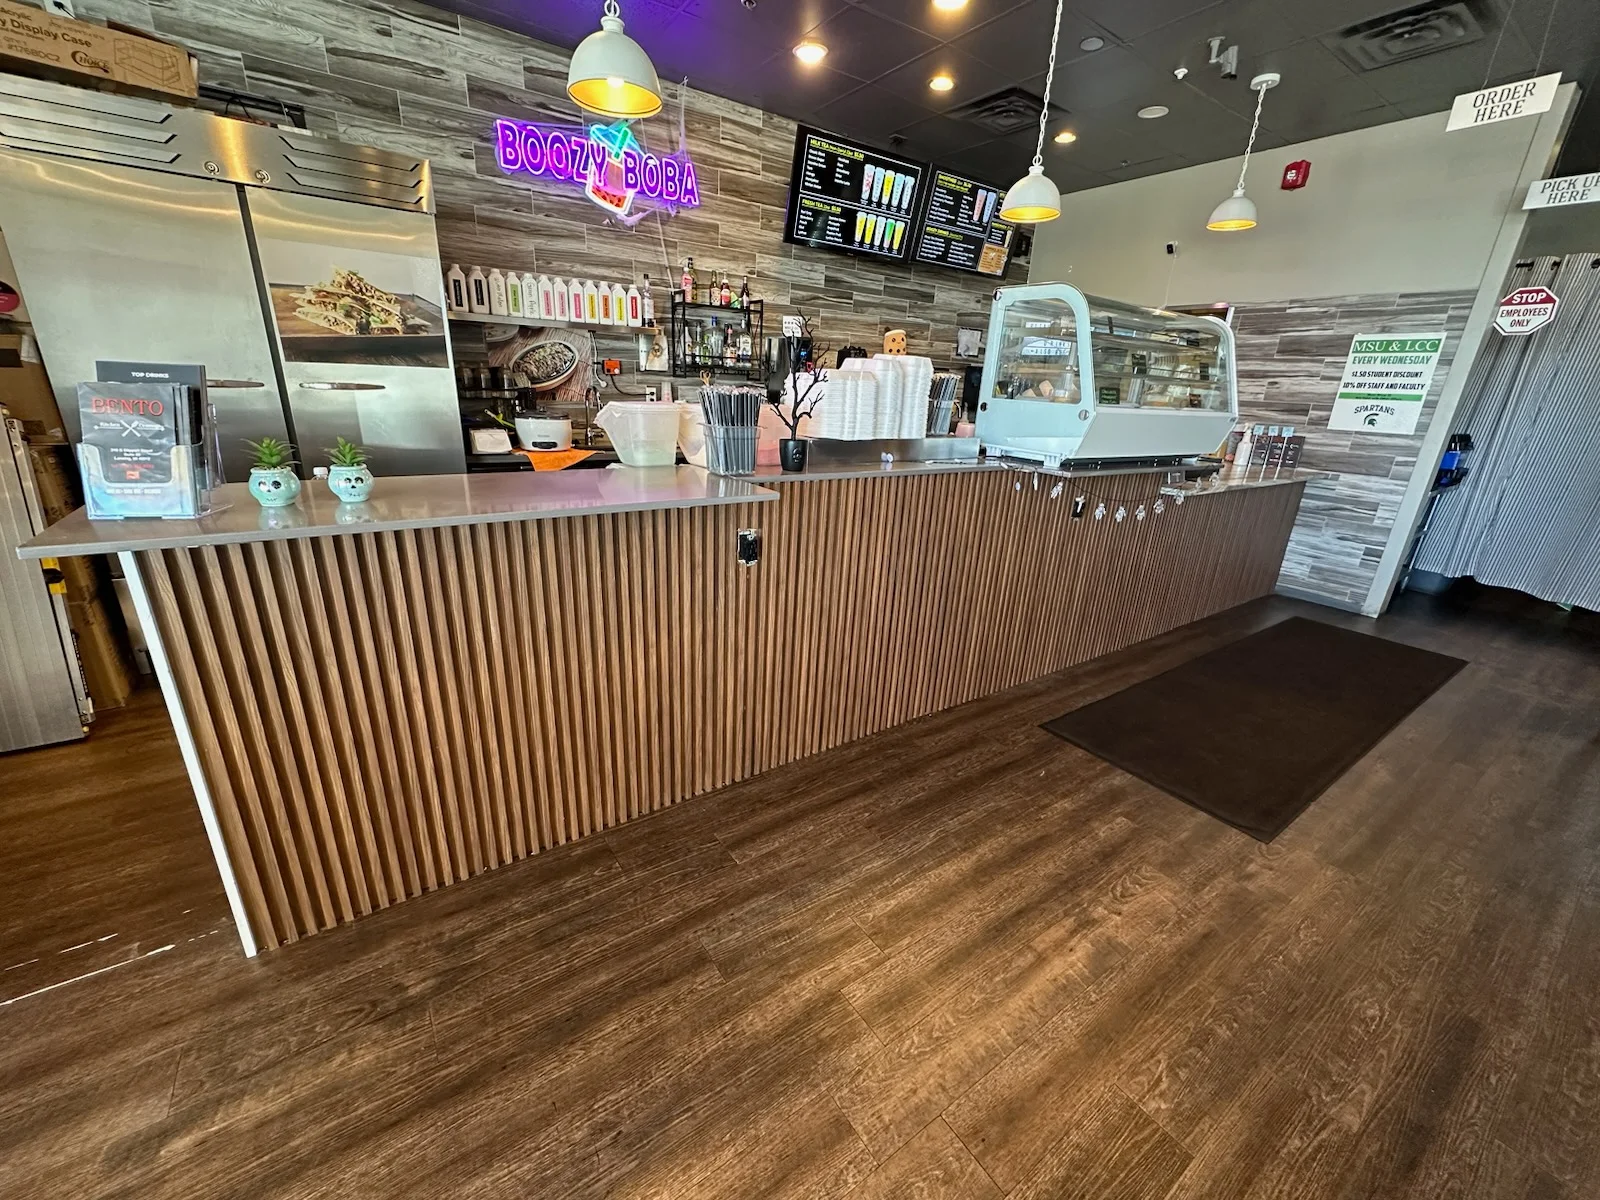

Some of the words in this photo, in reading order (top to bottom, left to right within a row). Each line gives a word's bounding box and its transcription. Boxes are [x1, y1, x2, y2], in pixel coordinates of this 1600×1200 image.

[10, 19, 58, 40] Display
[61, 33, 92, 48] Case
[1473, 81, 1537, 109] ORDER
[1474, 99, 1525, 123] HERE
[497, 119, 608, 186] BOOZY
[623, 149, 699, 205] BOBA
[1541, 177, 1579, 194] PICK
[1546, 189, 1591, 205] HERE
[1511, 292, 1547, 304] STOP
[1500, 307, 1549, 318] EMPLOYEES
[1510, 319, 1531, 328] ONLY
[1353, 341, 1387, 352] MSU
[1388, 340, 1401, 351] &
[1405, 340, 1438, 351] LCC
[1352, 355, 1379, 365] EVERY
[1379, 355, 1433, 365] WEDNESDAY
[91, 397, 164, 417] BENTO
[1354, 404, 1395, 415] SPARTANS
